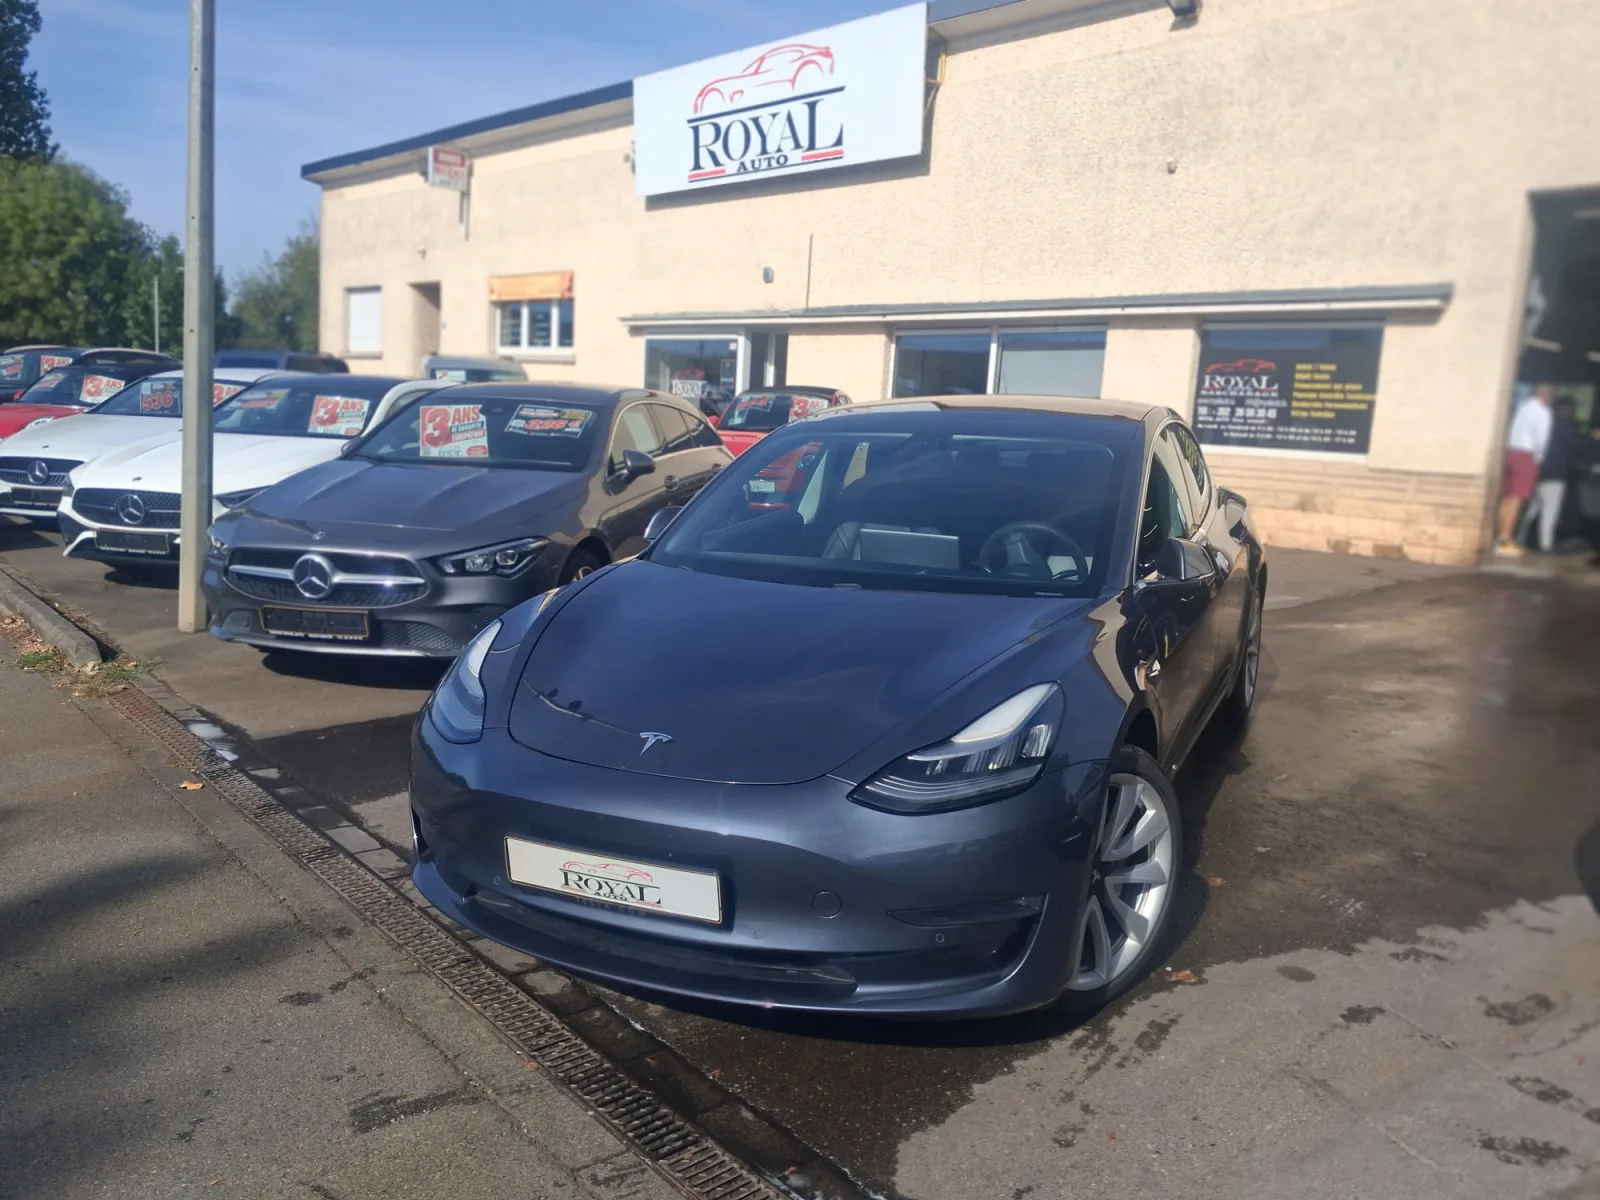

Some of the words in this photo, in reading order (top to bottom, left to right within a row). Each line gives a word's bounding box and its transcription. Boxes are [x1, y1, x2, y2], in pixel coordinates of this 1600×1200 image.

[688, 98, 843, 171] ROYAL
[736, 154, 789, 173] AUTO
[85, 375, 104, 397] 3
[1204, 375, 1279, 390] ROYAL
[315, 399, 339, 427] 3
[340, 400, 365, 411] ANS
[422, 407, 451, 449] 3
[451, 405, 481, 425] ANS
[562, 871, 661, 904] ROYAL
[594, 891, 628, 901] AUTO
